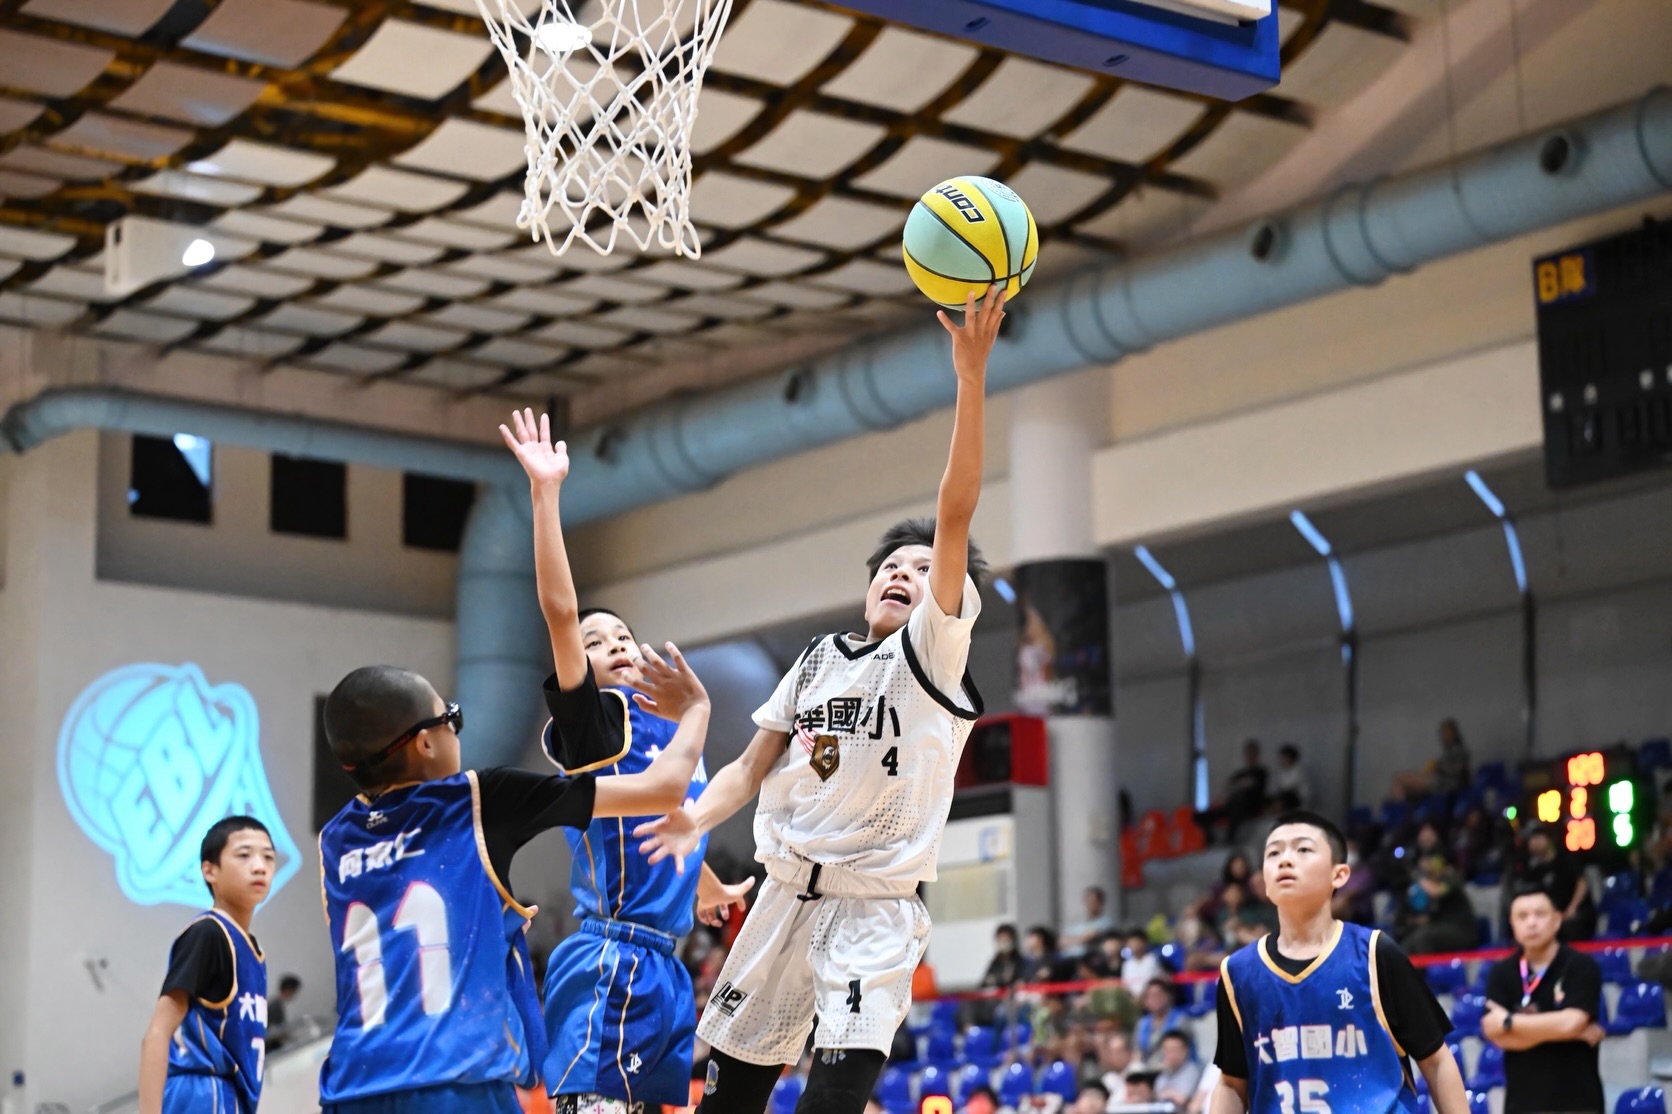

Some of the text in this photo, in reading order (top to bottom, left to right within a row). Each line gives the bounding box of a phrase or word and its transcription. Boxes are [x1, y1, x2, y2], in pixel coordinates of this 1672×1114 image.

[786, 695, 901, 748] 華國小
[881, 746, 899, 776] 4
[341, 880, 454, 1033] 11
[845, 979, 862, 1014] 4
